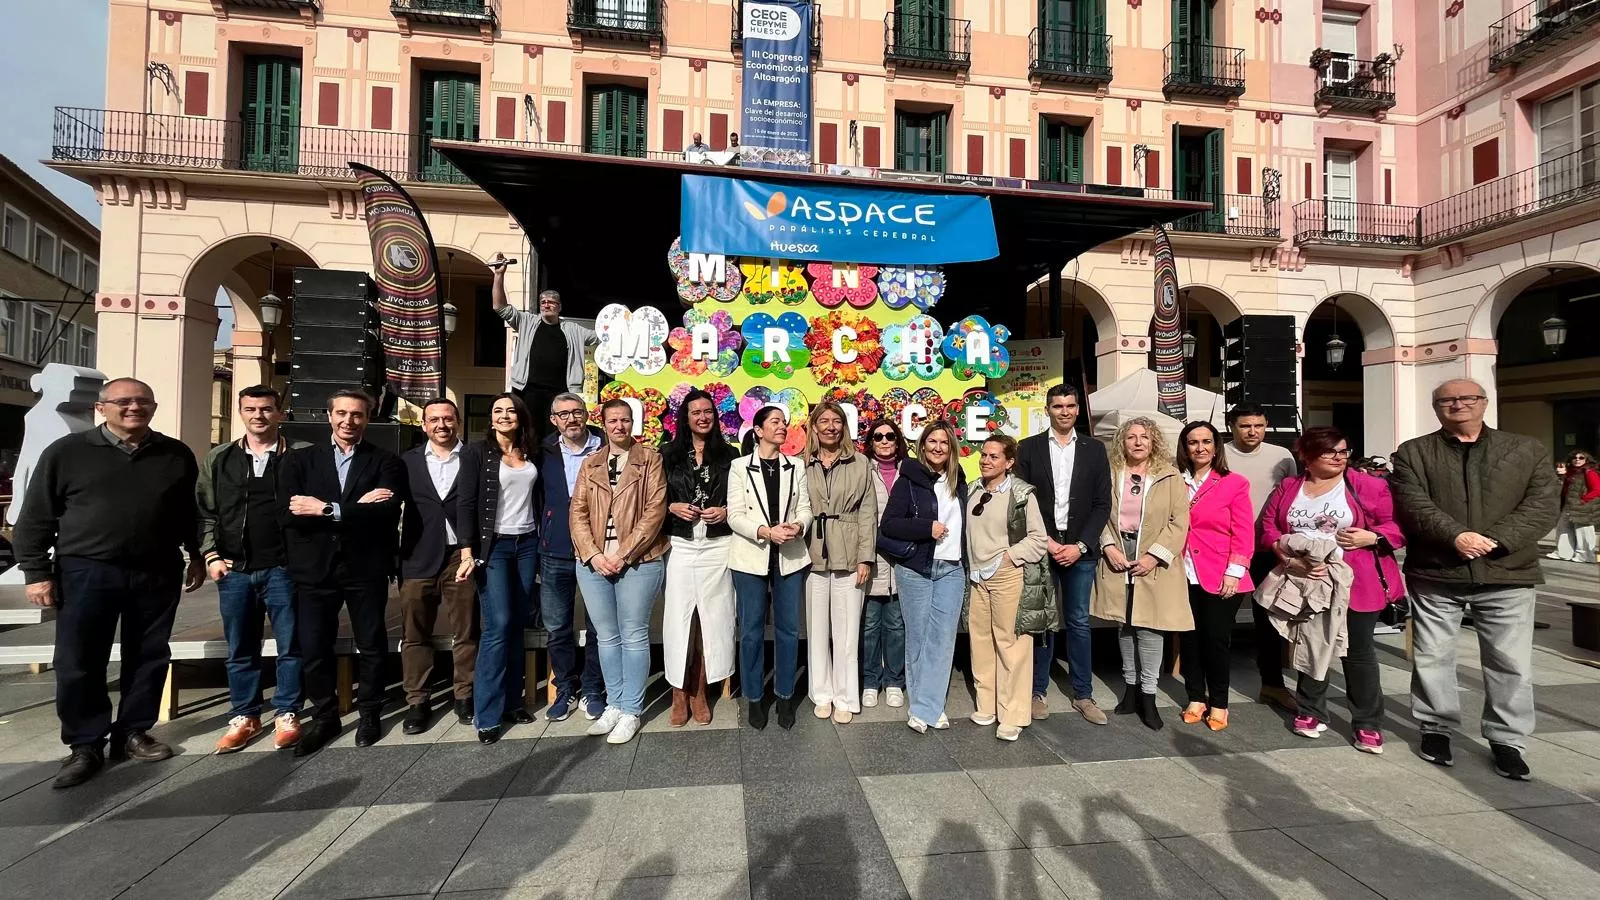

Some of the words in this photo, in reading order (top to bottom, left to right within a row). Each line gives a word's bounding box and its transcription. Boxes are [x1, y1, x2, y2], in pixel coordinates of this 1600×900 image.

[750, 8, 788, 21] CEOE
[750, 19, 788, 29] CEPYME
[750, 26, 788, 36] HUESCA
[751, 50, 761, 59] III
[762, 51, 804, 63] Congreso
[745, 60, 794, 72] Económico
[795, 65, 809, 74] del
[753, 72, 801, 84] Altoaragón
[763, 98, 801, 109] EMPRESA:
[745, 107, 763, 115] Clave
[764, 108, 775, 116] del
[775, 110, 808, 119] desarrollo
[749, 115, 803, 126] socioeconómico
[791, 196, 936, 227] ASPACE
[769, 224, 852, 236] PARÁLISIS
[863, 229, 936, 242] CEREBRAL
[769, 241, 820, 254] Huesca
[608, 318, 992, 366] MARCHA
[1321, 502, 1345, 518] la
